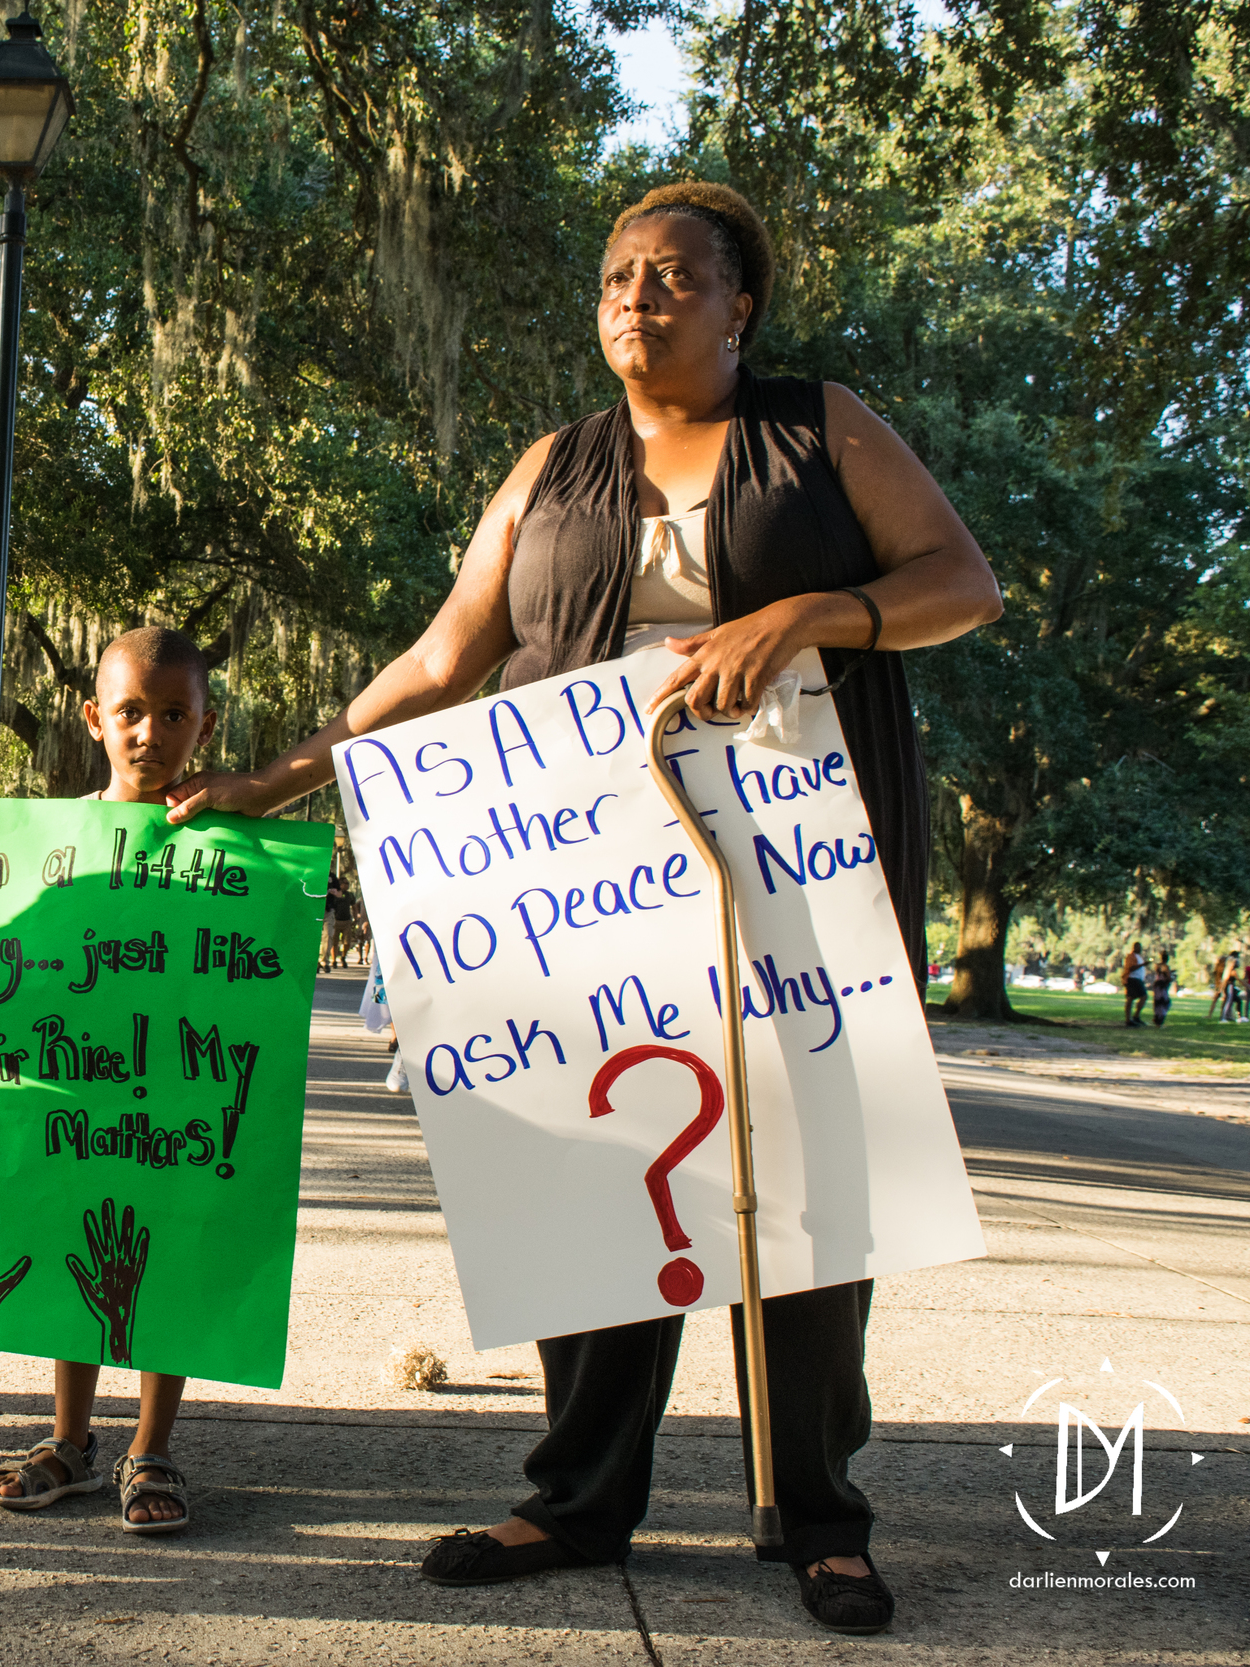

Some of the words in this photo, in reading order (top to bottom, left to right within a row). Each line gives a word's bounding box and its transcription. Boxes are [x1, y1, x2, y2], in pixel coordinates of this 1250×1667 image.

[488, 699, 546, 787] A
[726, 744, 847, 813] have
[42, 846, 76, 888] a
[109, 828, 249, 896] little
[511, 852, 701, 977] peace
[752, 823, 876, 895] Now
[68, 929, 169, 993] just
[193, 928, 284, 982] like
[32, 1013, 149, 1099] Rice!
[179, 1016, 260, 1114] My
[424, 1017, 567, 1096] ask
[588, 974, 691, 1052] Me
[45, 1105, 239, 1179] Matters!
[588, 1044, 725, 1307] ?
